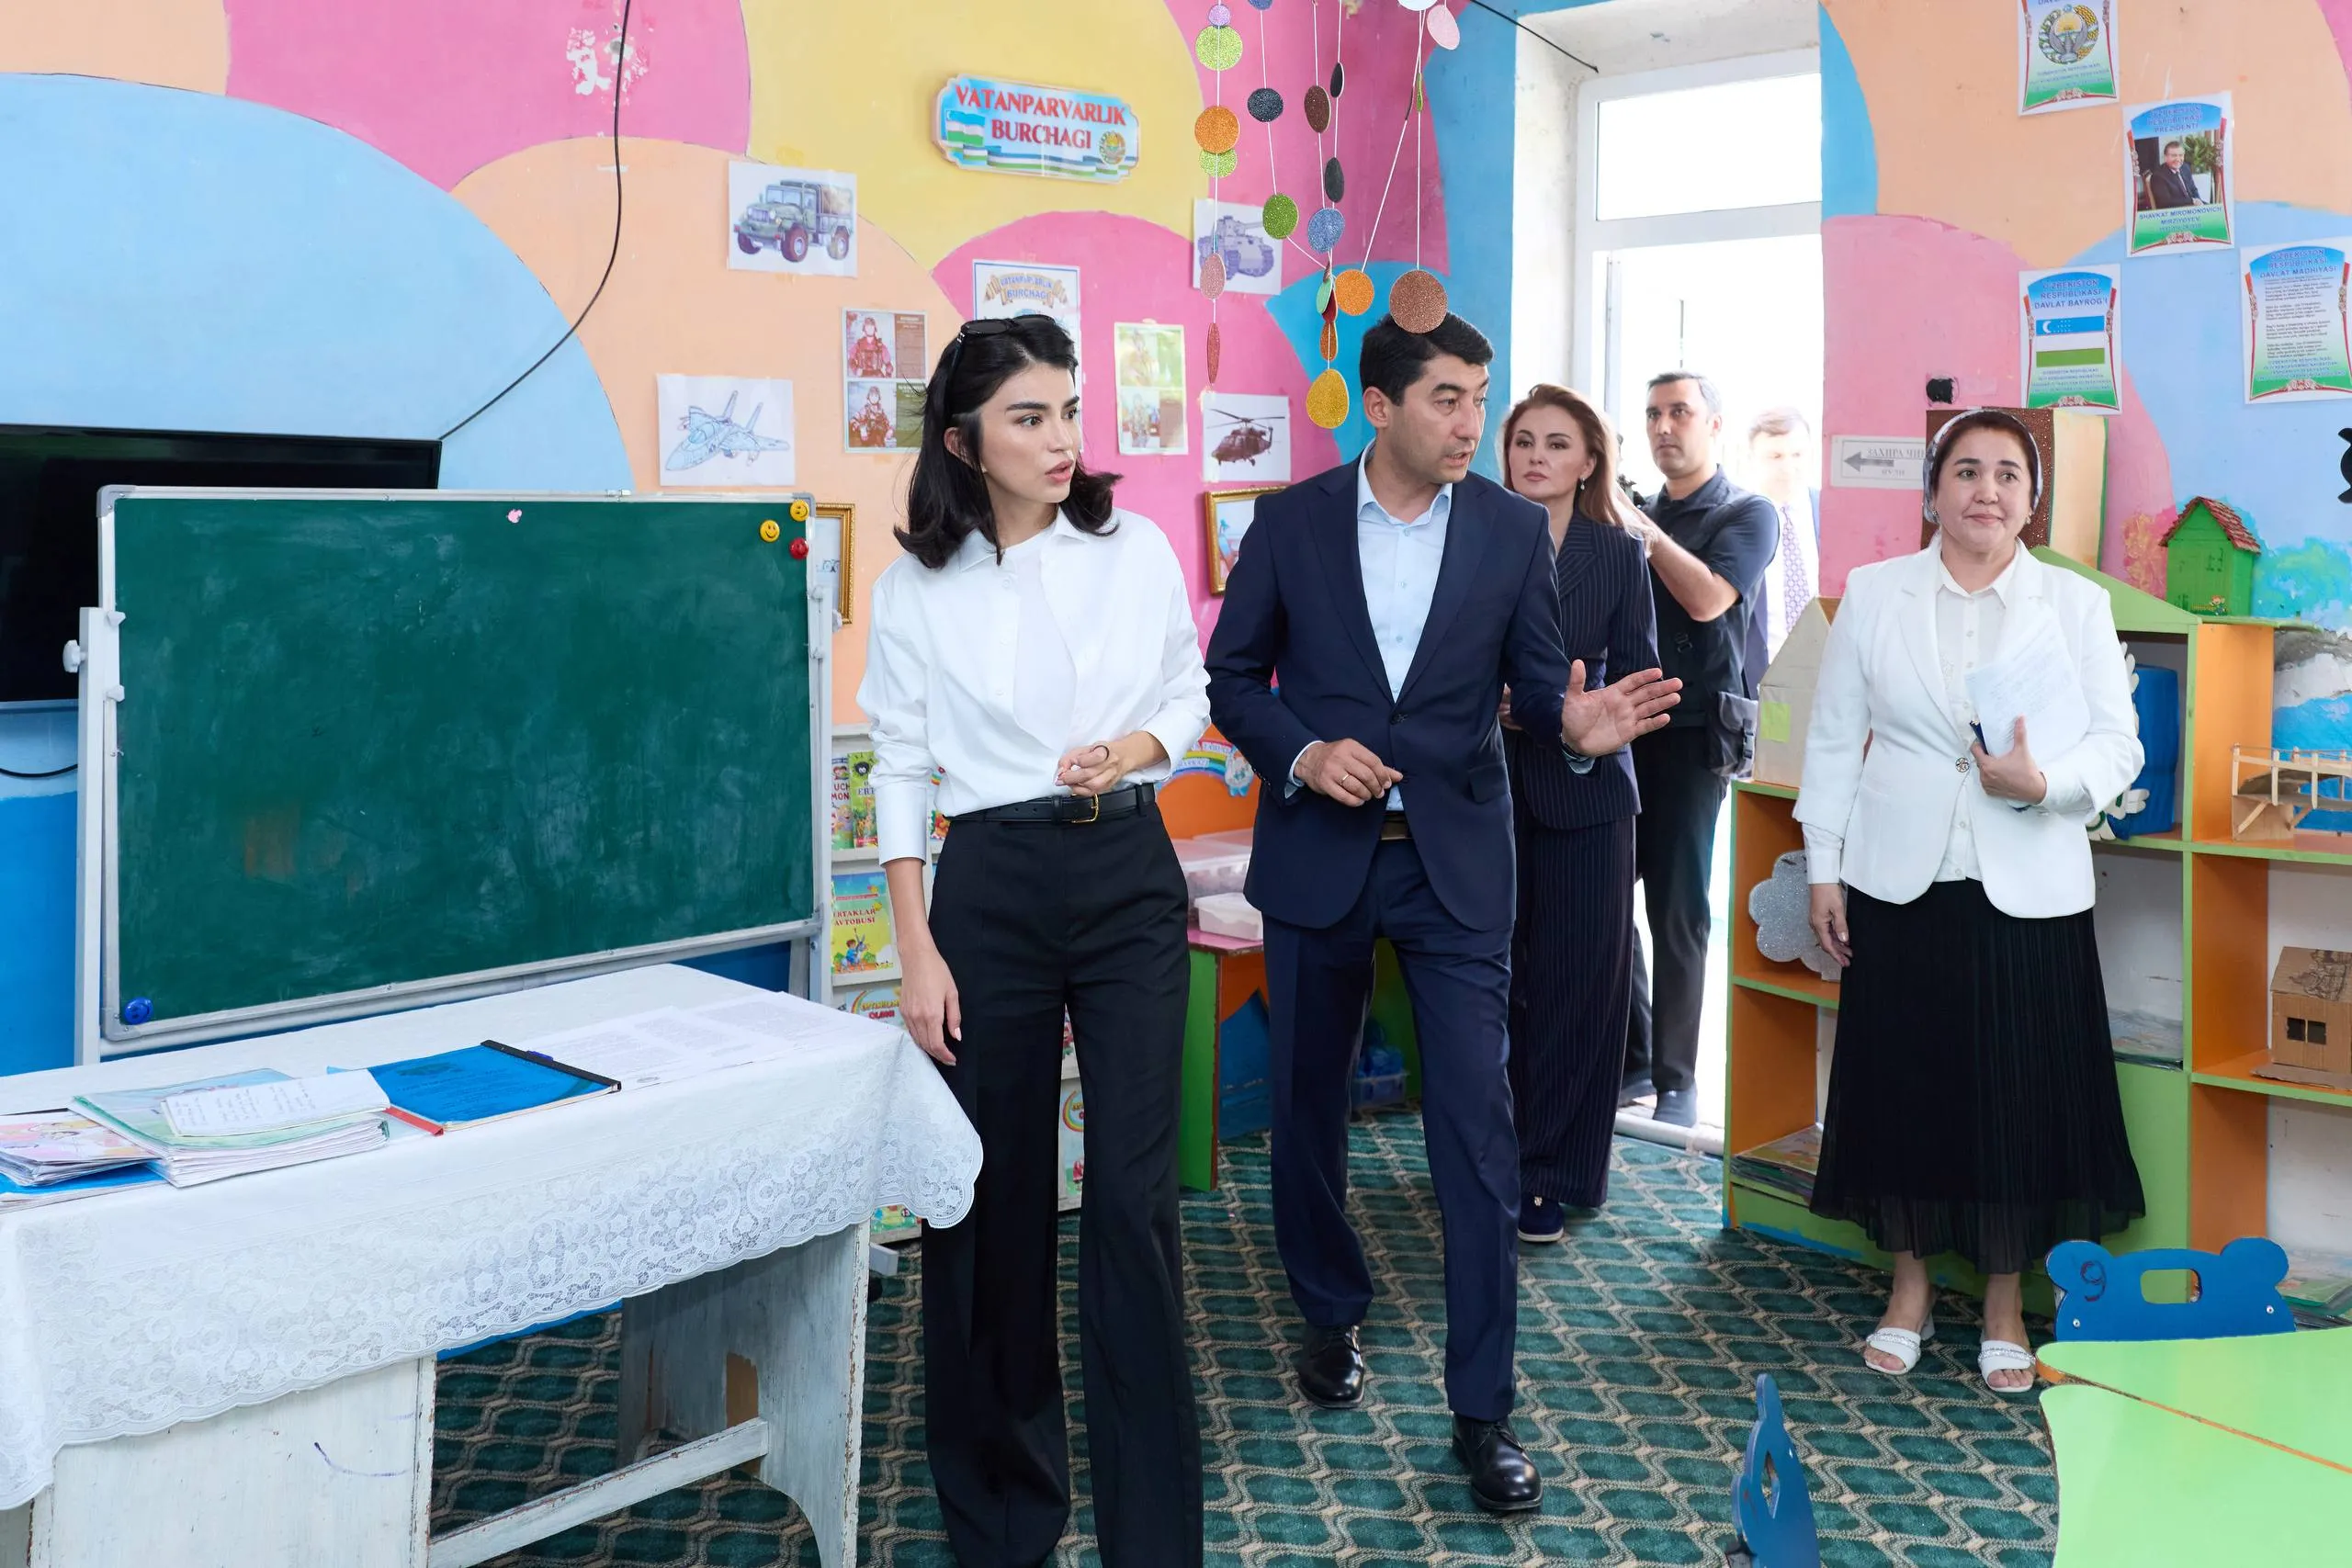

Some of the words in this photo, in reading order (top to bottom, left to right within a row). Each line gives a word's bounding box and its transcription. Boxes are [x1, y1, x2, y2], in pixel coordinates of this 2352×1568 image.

[956, 85, 1126, 126] VATANPARVARLIK
[2154, 123, 2199, 133] PREZIDENTI
[991, 119, 1091, 149] BURCHAGI
[2269, 257, 2327, 268] RESPUBLIKASI
[2260, 269, 2290, 278] DAVLAT
[2041, 288, 2102, 299] RESPUBLIKASI
[2034, 300, 2067, 310] DAVLAT
[835, 917, 876, 927] AVTOBUSI
[2080, 1259, 2107, 1302] 9
